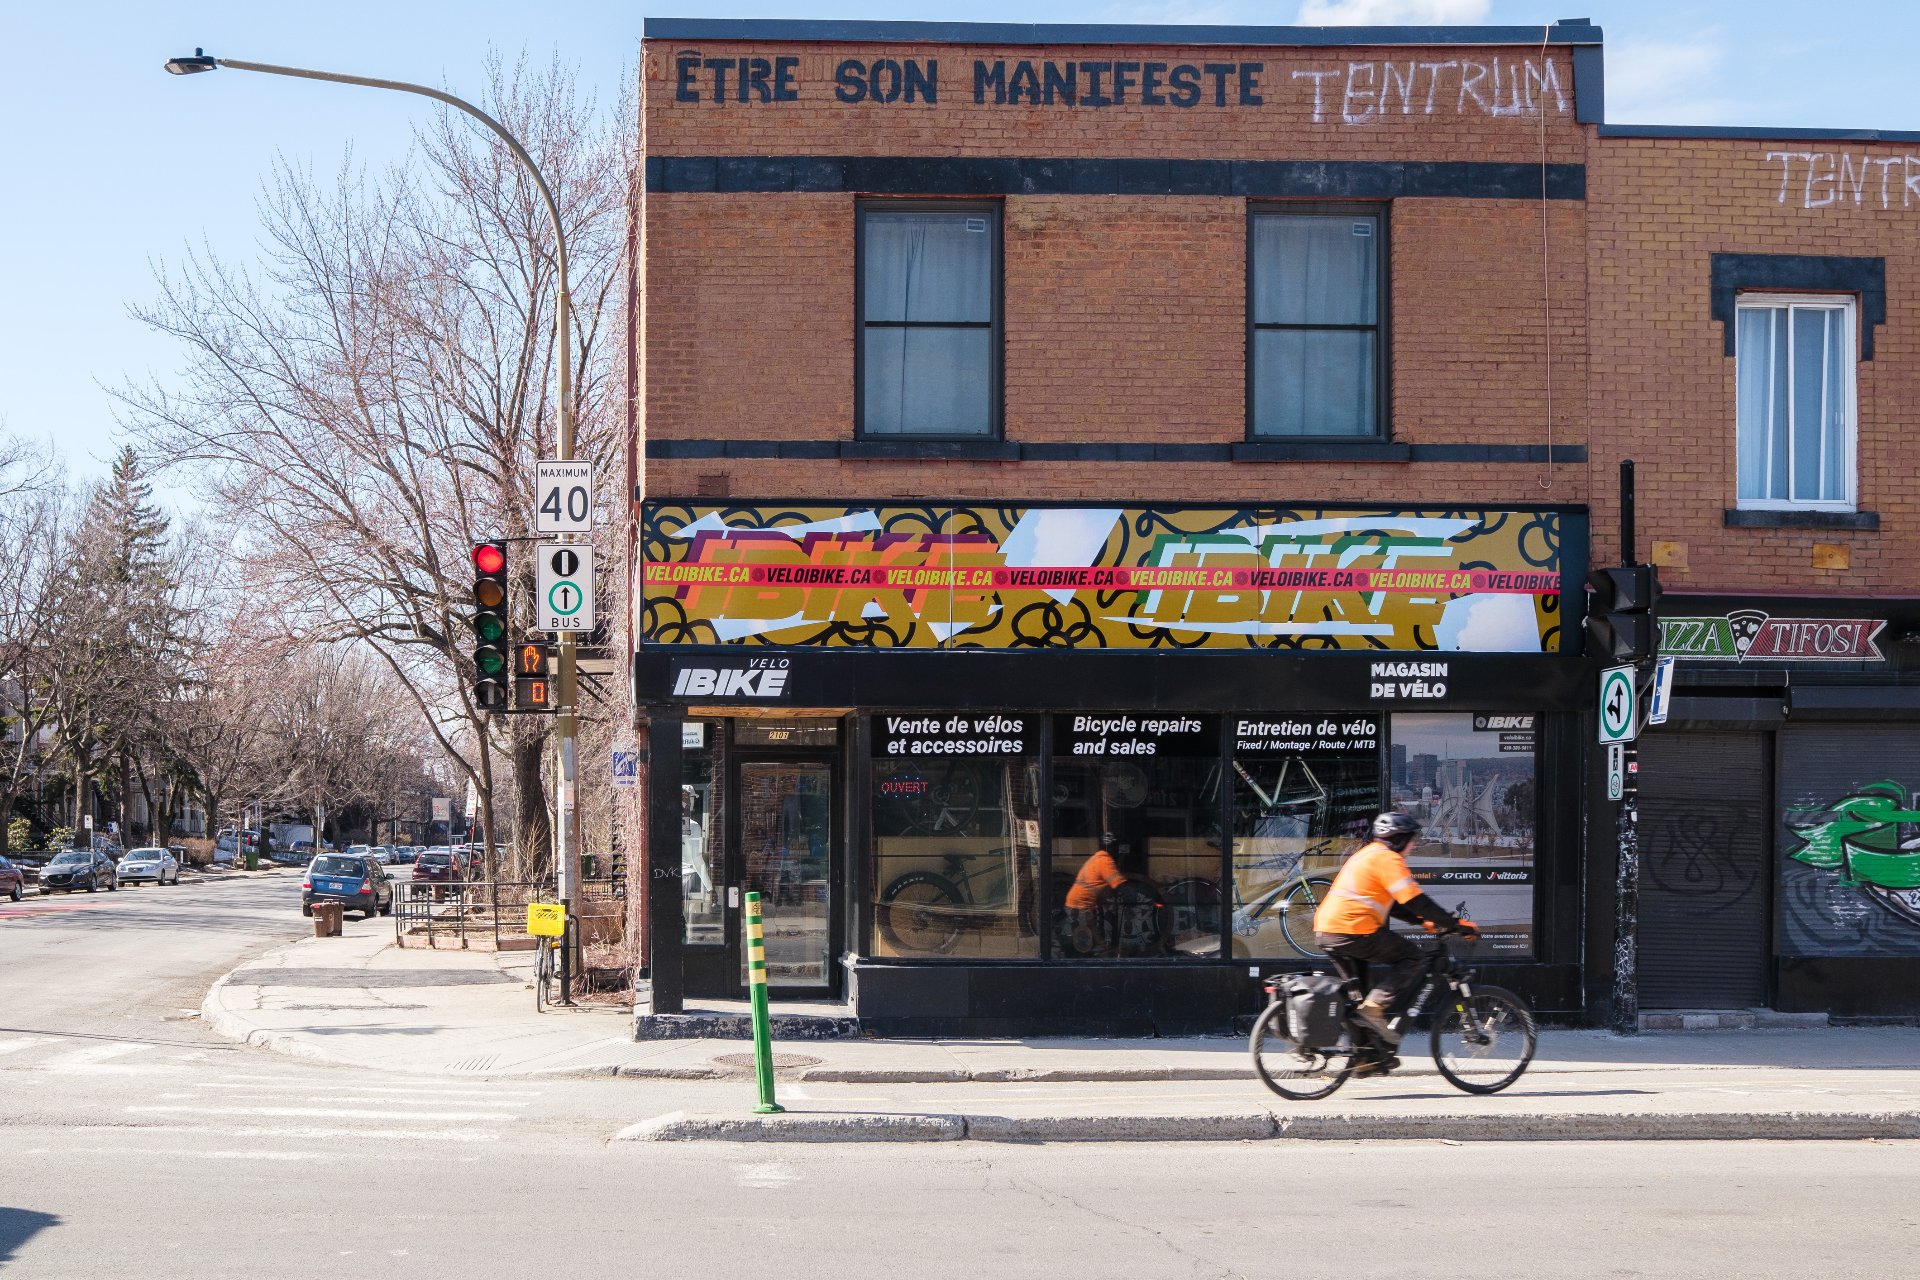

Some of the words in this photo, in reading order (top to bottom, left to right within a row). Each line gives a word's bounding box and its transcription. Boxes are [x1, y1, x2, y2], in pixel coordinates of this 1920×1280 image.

[675, 50, 800, 103] ÊTRE
[835, 58, 938, 104] SON
[973, 59, 1264, 108] MANIFESTE
[1291, 56, 1567, 125] TENTRUM
[540, 468, 588, 478] MAXIMUM
[540, 485, 589, 523] 40
[645, 565, 750, 583] VELOIBIKE.CA
[766, 566, 871, 585] VELOIBIKE.CA
[887, 567, 993, 586] VELOIBIKE.CA
[1010, 568, 1114, 587] VELOIBIKE.CA
[1130, 570, 1233, 587] VELOIBIKE.CA
[1250, 571, 1353, 588] VELOIBIKE.CA
[1369, 572, 1471, 589] VELOIBIKE.CA
[551, 617, 580, 628] BUS
[1657, 622, 1721, 652] IZZA
[1770, 623, 1863, 654] TIFOSI
[749, 658, 790, 668] VELO
[1371, 662, 1448, 678] MAGASIN
[673, 669, 789, 696] IBIKE
[1371, 682, 1395, 698] DE
[1399, 680, 1447, 698] VÉLO
[886, 717, 941, 734] Vente
[945, 716, 969, 734] de
[974, 715, 1023, 733] vélos
[1073, 716, 1136, 736] Bicycle
[1140, 716, 1202, 737] repairs
[1236, 720, 1313, 736] Entretien
[1316, 720, 1337, 736] de
[1341, 720, 1376, 736] vélo
[1487, 716, 1534, 729] IBIKE
[887, 738, 908, 754] et
[910, 736, 1023, 754] accessoires
[1073, 738, 1106, 755] and
[1109, 738, 1156, 756] sales
[1237, 739, 1262, 750] Fixed
[1270, 740, 1311, 752] Montage
[1319, 740, 1346, 750] Route
[1354, 740, 1375, 750] MTB
[881, 782, 929, 793] OUVERT
[1455, 872, 1482, 880] GIRO
[1496, 871, 1528, 881] vittoria
